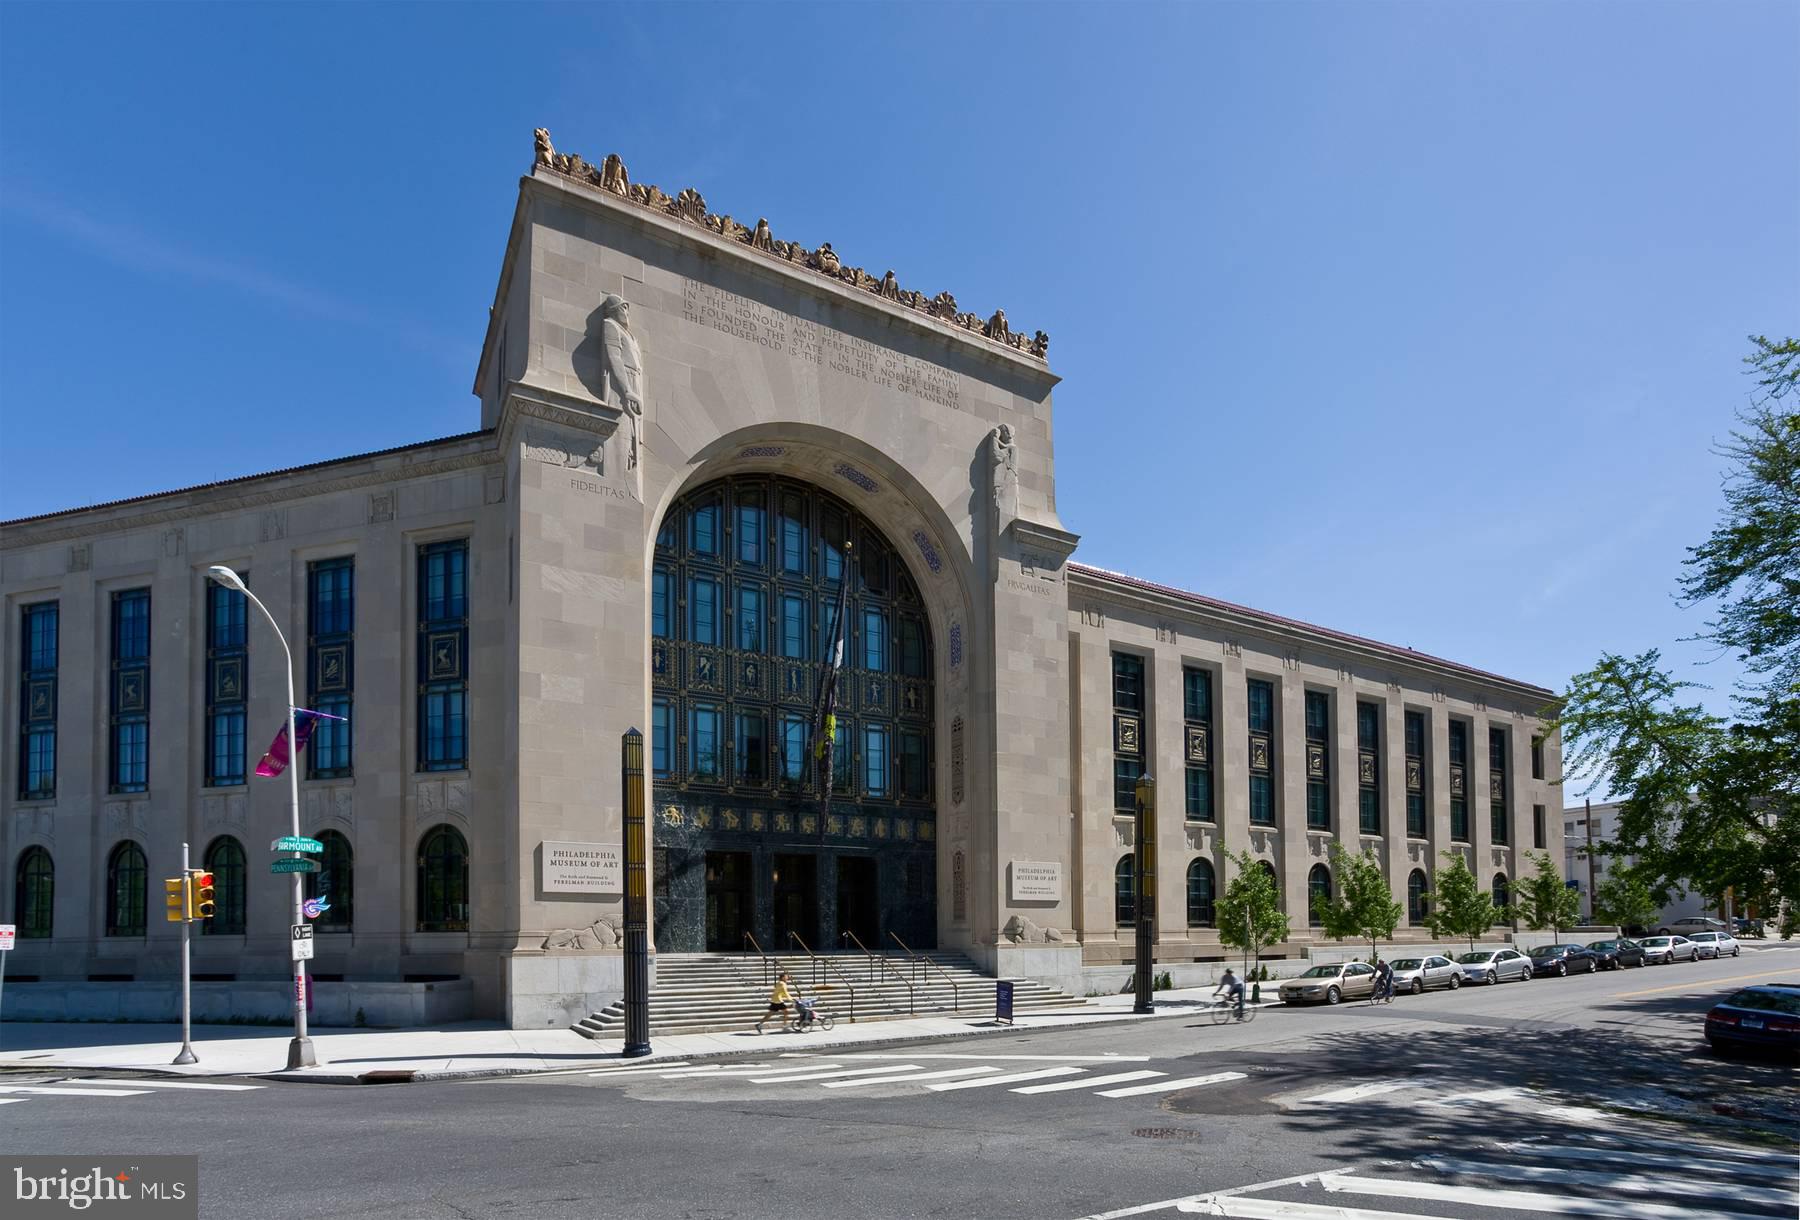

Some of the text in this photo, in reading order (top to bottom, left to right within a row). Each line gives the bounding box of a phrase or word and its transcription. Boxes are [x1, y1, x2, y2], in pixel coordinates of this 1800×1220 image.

[682, 310, 960, 410] THE HOUSEHOLD IS THE NOBLER LIFE OF MANKIND
[683, 280, 959, 381] THE FIDELITY MUTUAL LIFE INSURANCE COMPANY
[683, 288, 959, 391] IN THE HONOUR AND PERPETUITY OF THE FAMILY
[683, 299, 960, 401] IS FOUNDED THE STATE IN THE NOBLER LIFE OF
[570, 479, 625, 499] FIDELITAS
[553, 850, 616, 859] PHILADELPHIA
